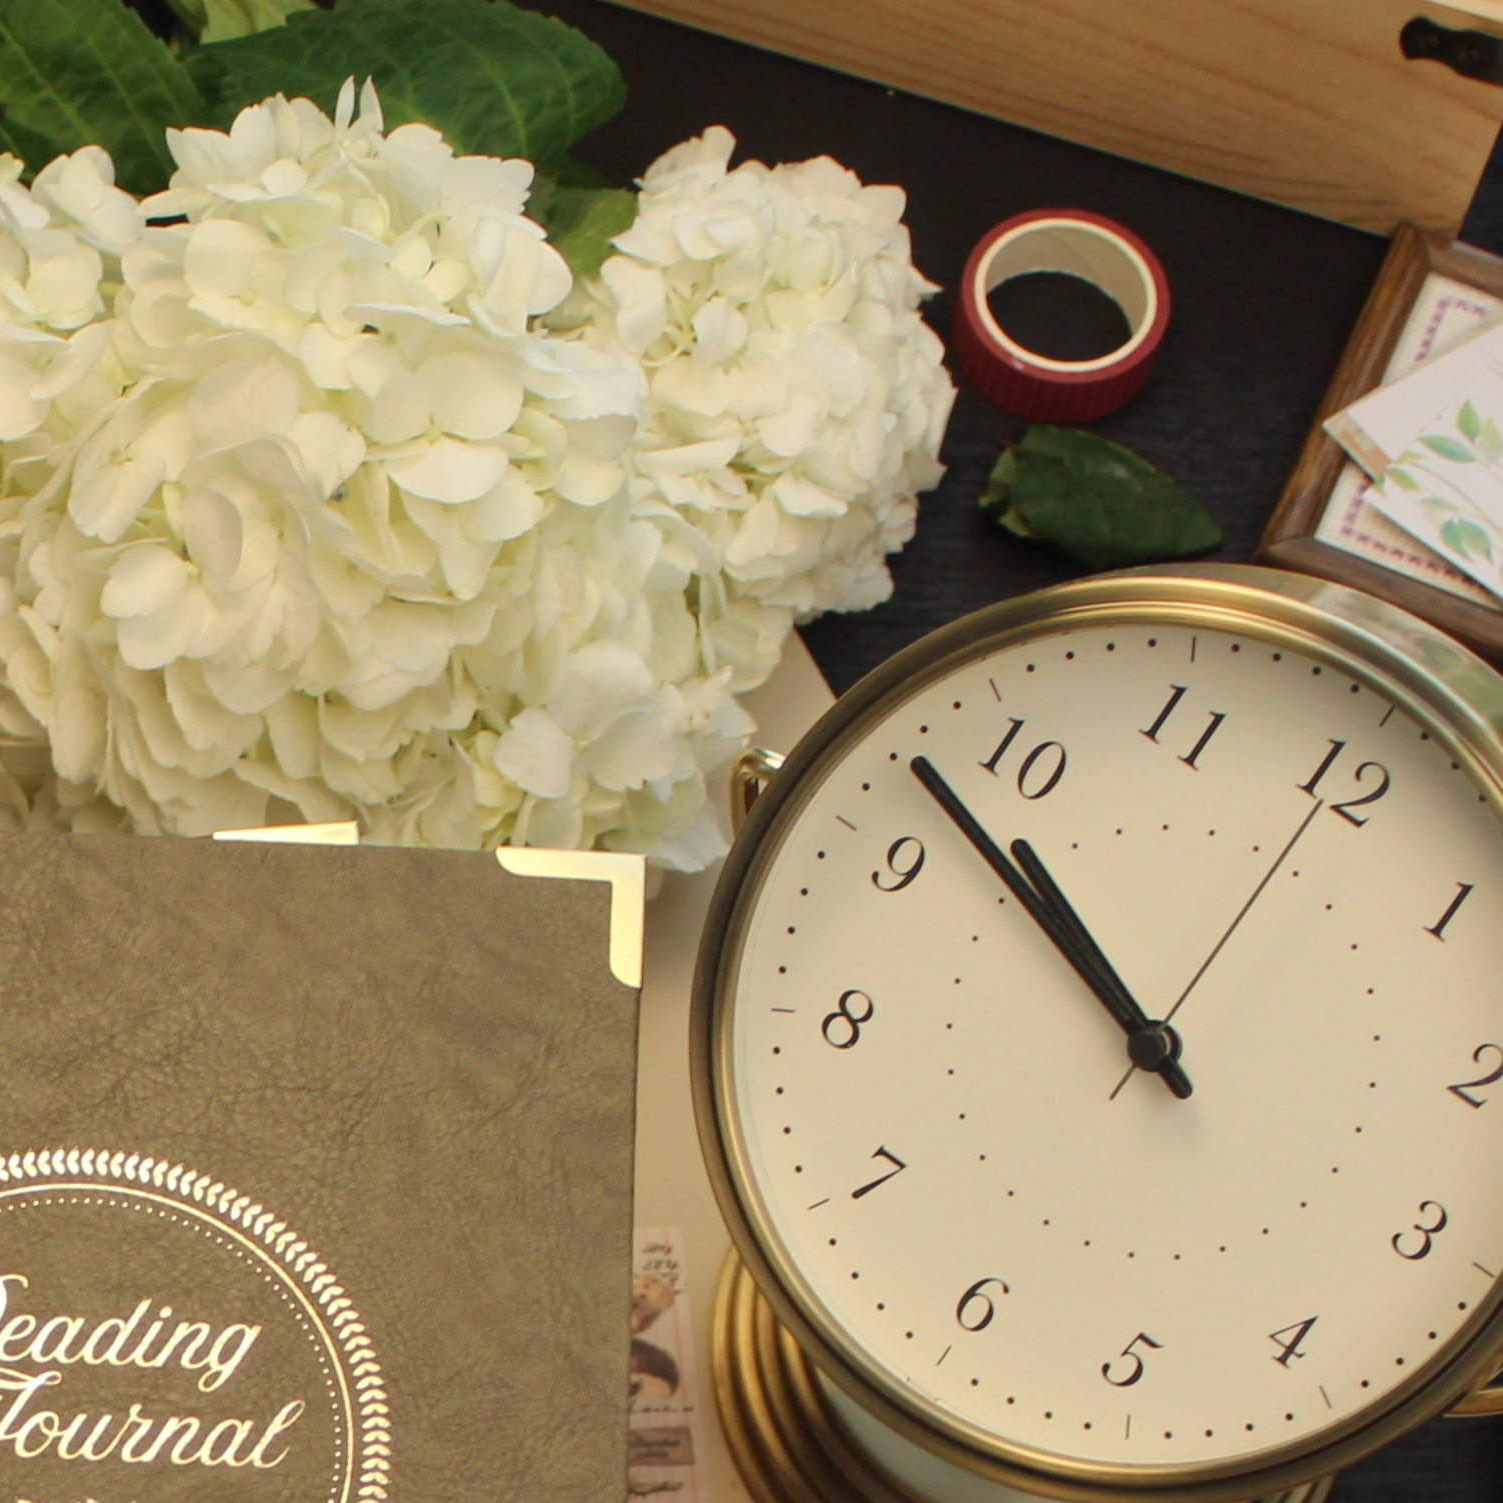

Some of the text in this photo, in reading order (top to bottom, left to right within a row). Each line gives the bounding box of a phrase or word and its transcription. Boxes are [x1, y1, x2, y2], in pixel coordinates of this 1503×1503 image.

[1140, 685, 1226, 769] 11
[979, 718, 1066, 799] 10
[1297, 738, 1391, 828] 12
[872, 837, 925, 892] 9
[1425, 882, 1474, 941] 1
[822, 990, 873, 1049] 8
[1447, 1044, 1503, 1109] 2
[852, 1146, 906, 1199] 7
[1392, 1201, 1447, 1260] 3
[957, 1278, 1009, 1331] 6
[1102, 1333, 1162, 1387] 5
[1269, 1316, 1318, 1368] 4
